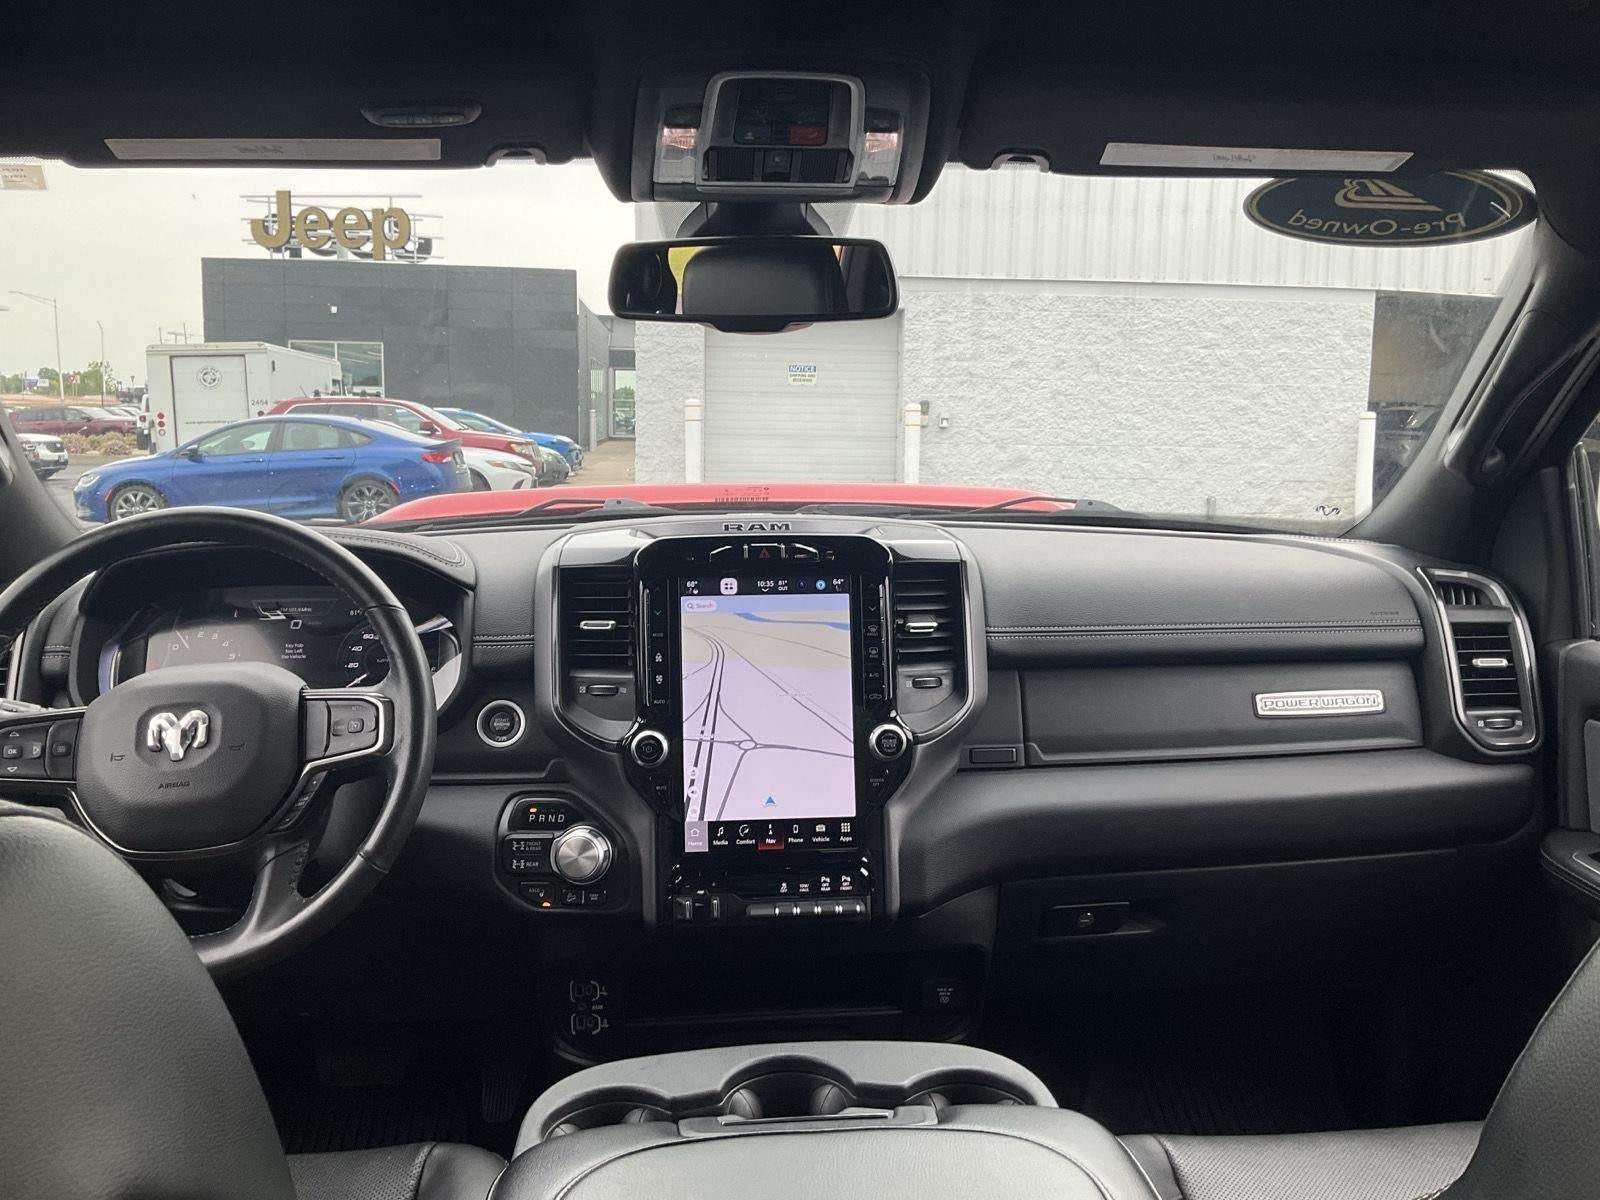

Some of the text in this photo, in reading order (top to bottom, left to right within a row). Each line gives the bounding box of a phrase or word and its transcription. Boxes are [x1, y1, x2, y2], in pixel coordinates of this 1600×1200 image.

[251, 190, 411, 261] Jeep
[724, 523, 791, 532] RAM
[290, 619, 303, 630] 0
[172, 643, 179, 651] 0
[1263, 696, 1377, 709] POWER WAGON
[158, 780, 191, 789] AIRBAG
